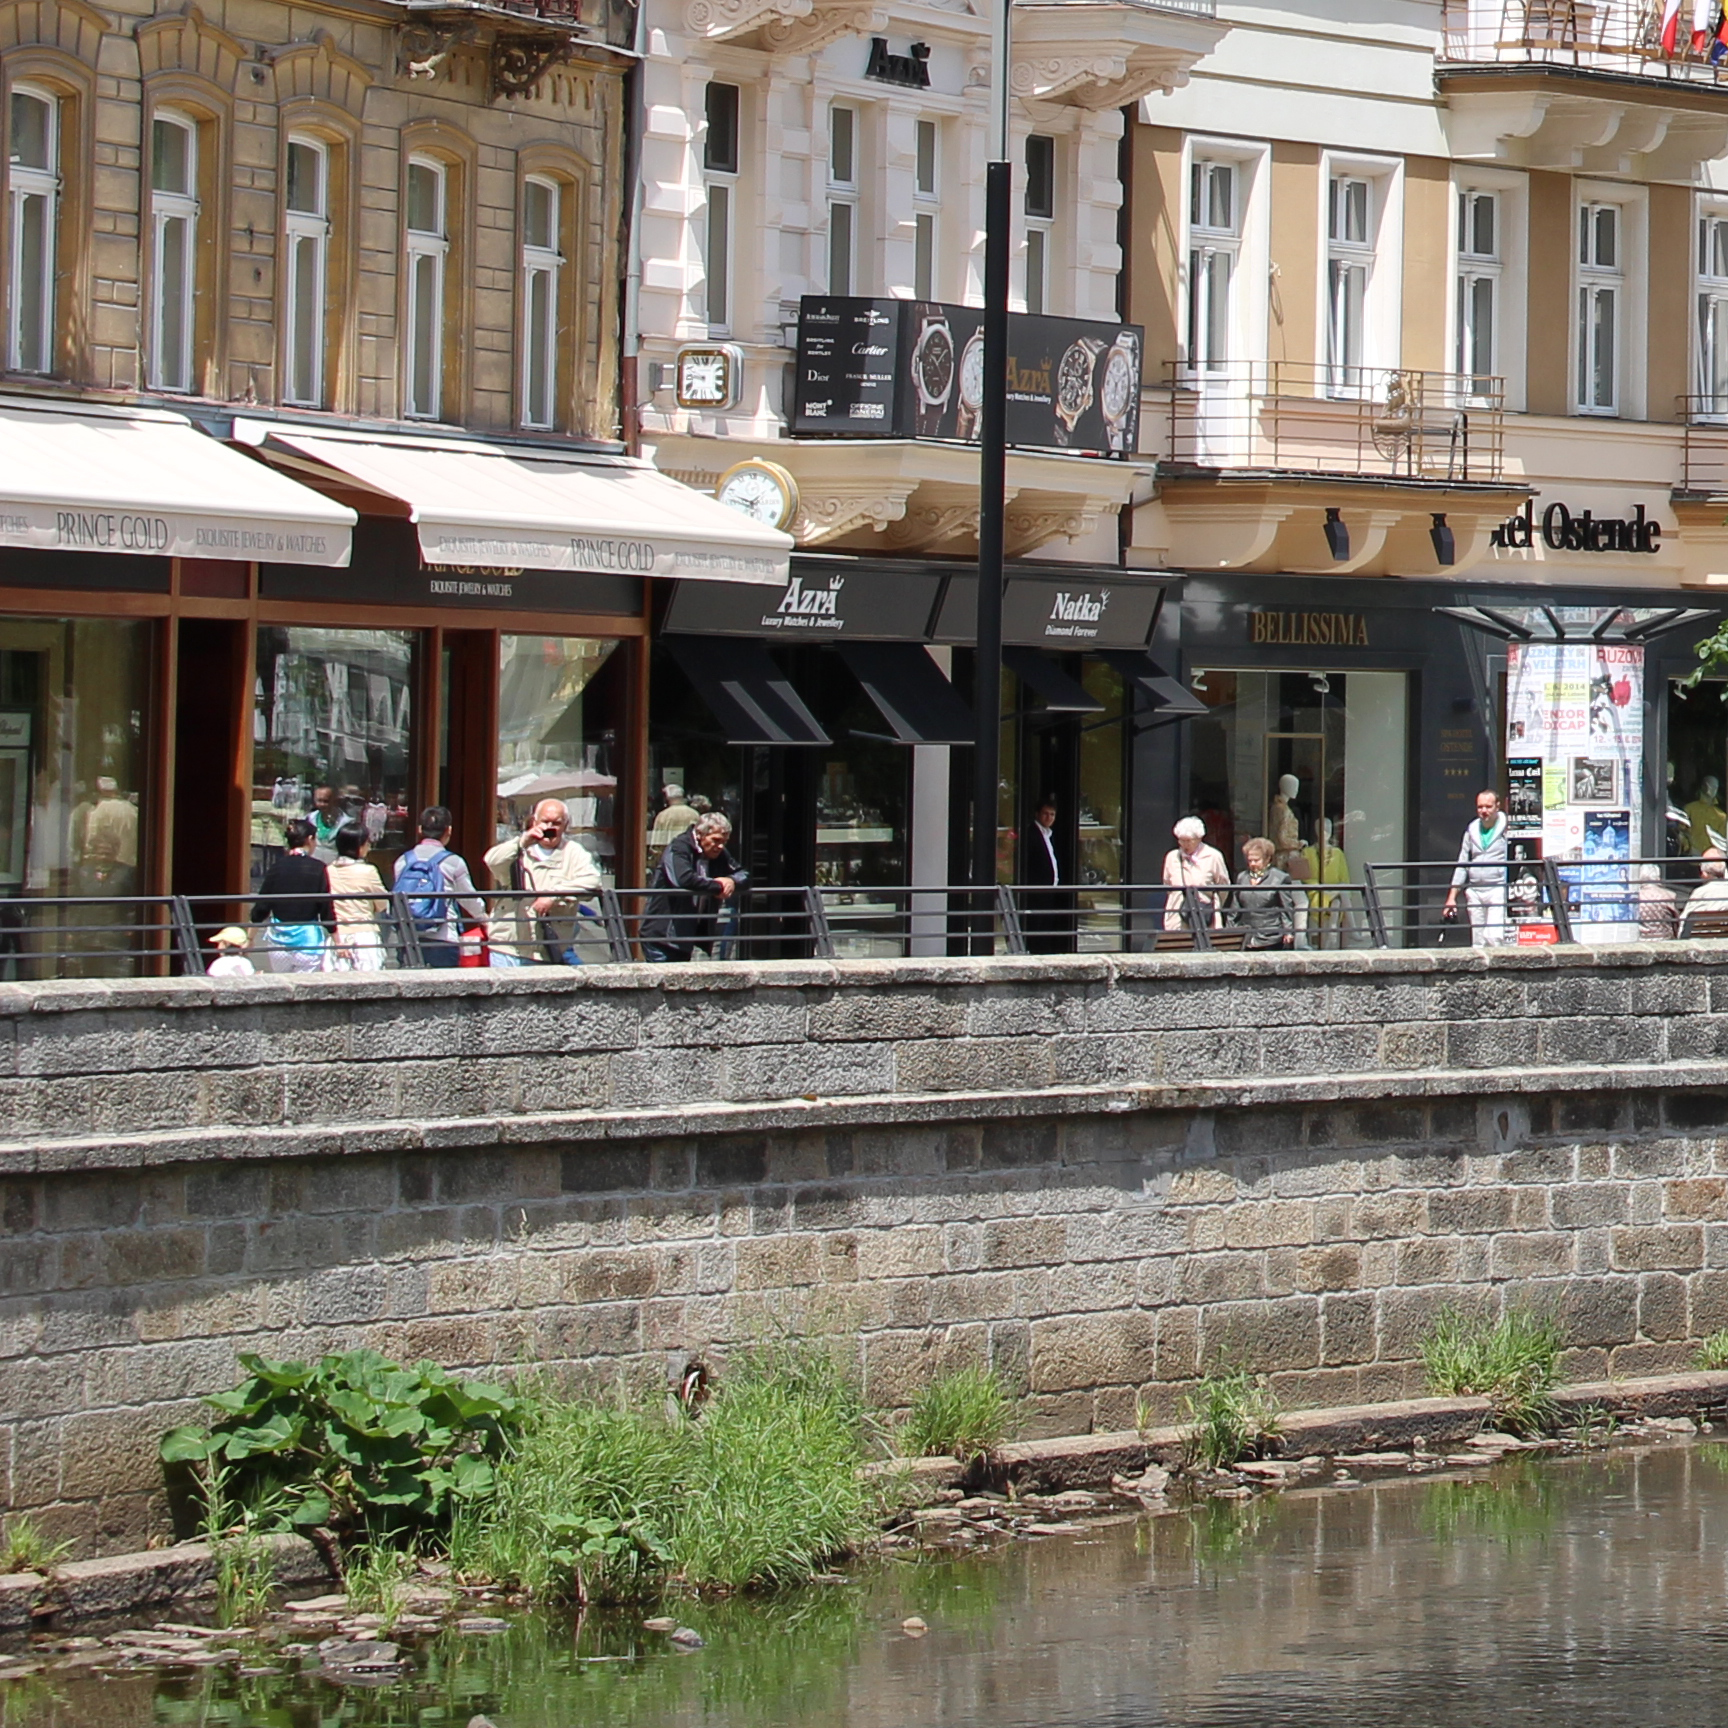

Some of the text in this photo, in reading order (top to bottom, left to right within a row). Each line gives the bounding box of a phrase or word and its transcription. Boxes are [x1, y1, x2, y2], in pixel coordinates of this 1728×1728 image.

[851, 341, 889, 356] Cartier
[57, 511, 116, 547] PRINCE
[120, 515, 168, 550] GOLD
[196, 527, 239, 548] EXQUISITE
[286, 535, 326, 554] WATCHES
[1542, 502, 1661, 554] Ostende
[570, 538, 615, 569] PRINCE
[618, 542, 655, 571] GOLD
[1050, 592, 1101, 622] Natka
[761, 614, 782, 629] Luxury
[783, 616, 808, 628] Watches
[816, 617, 844, 631] Jewellery
[1045, 624, 1098, 638] Diamond Forever
[1253, 611, 1370, 646] BELLISSIMA
[1564, 683, 1586, 691] 2014
